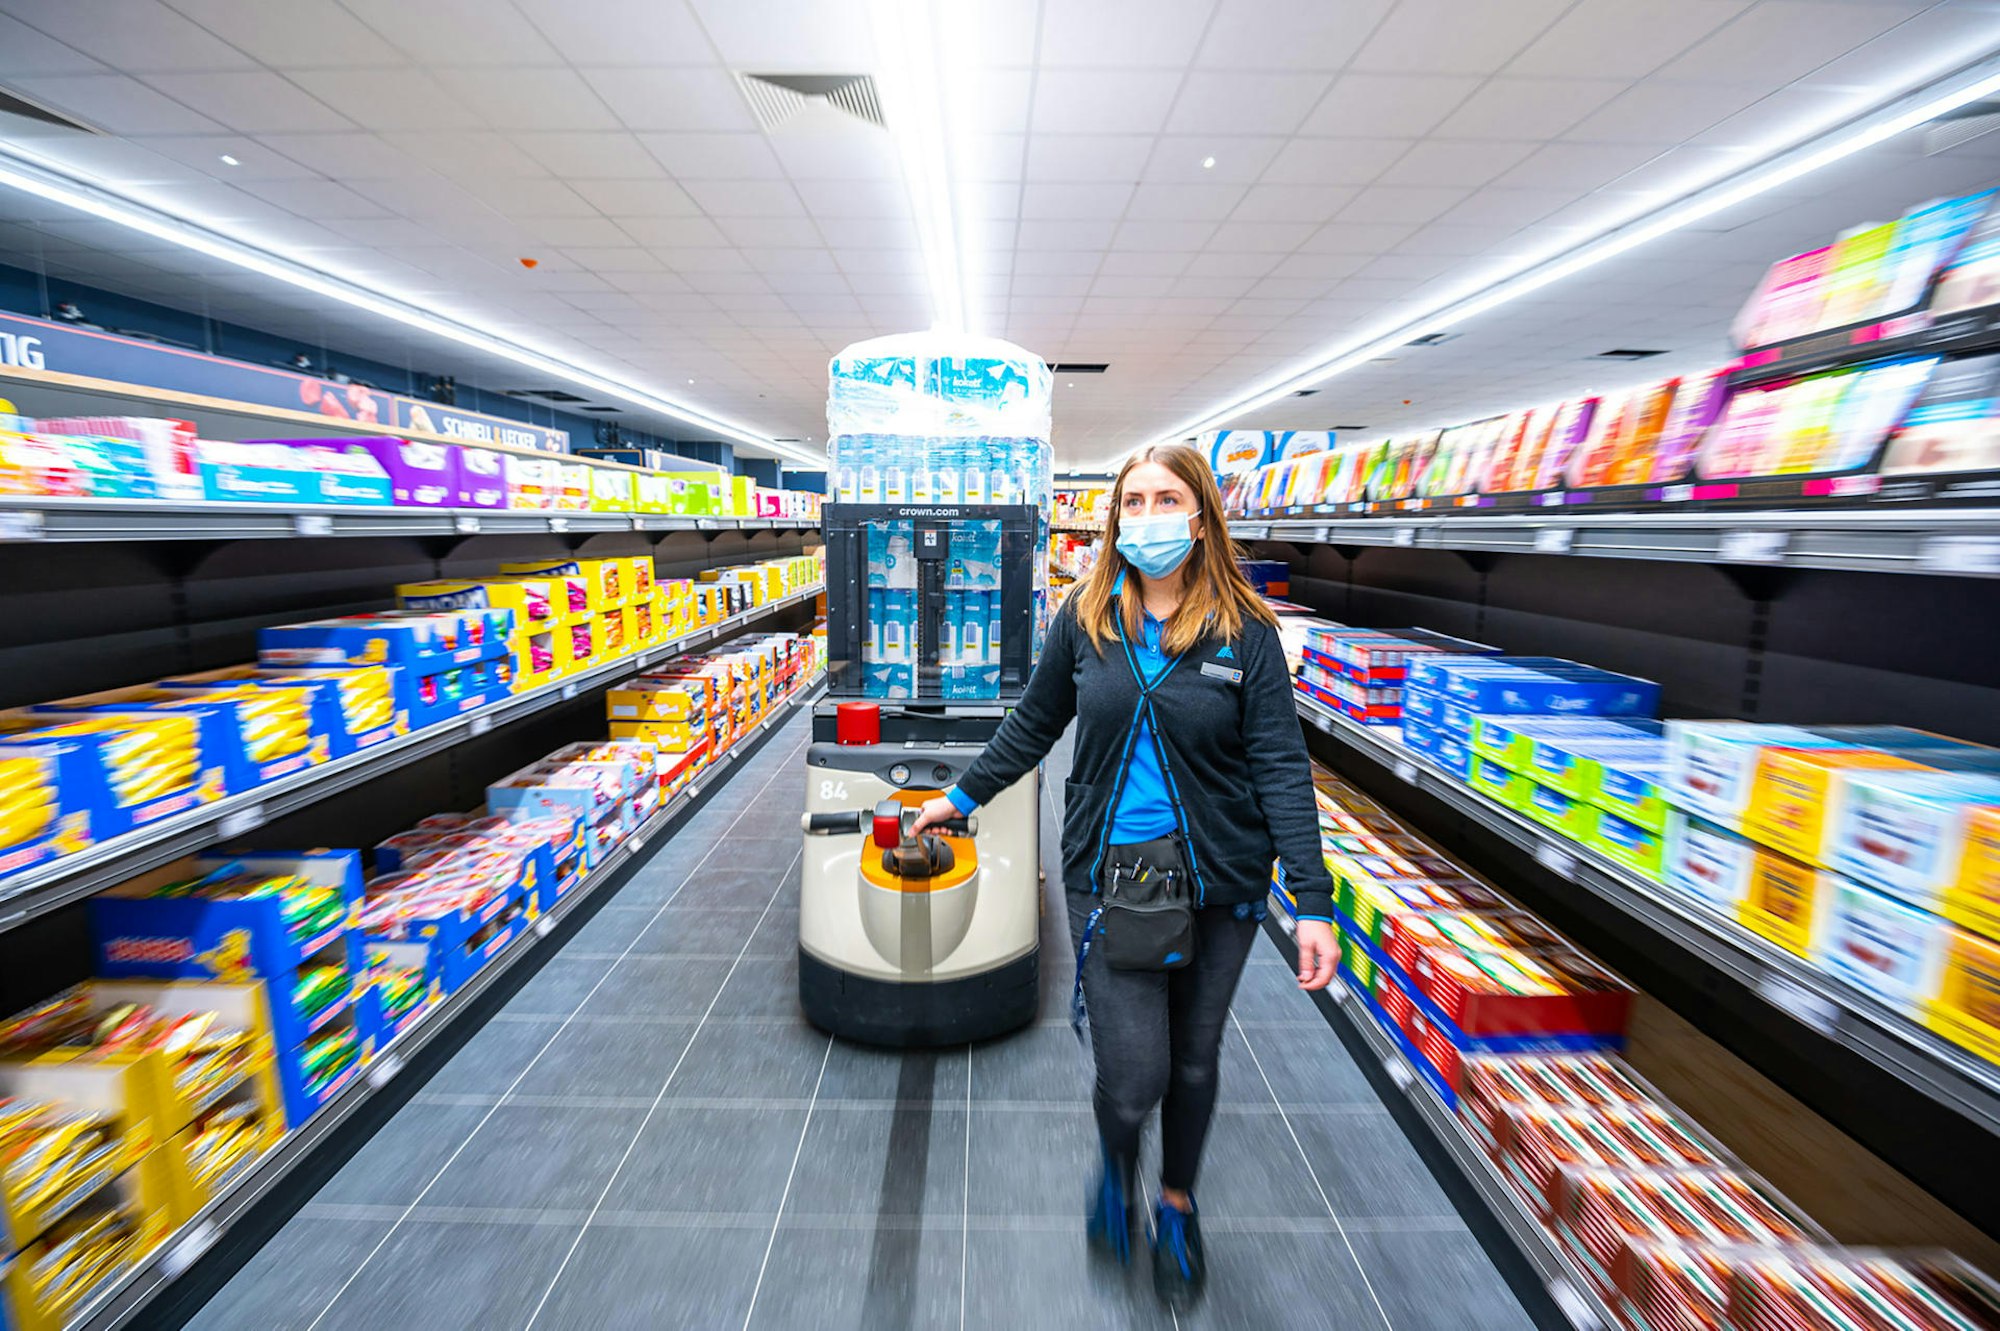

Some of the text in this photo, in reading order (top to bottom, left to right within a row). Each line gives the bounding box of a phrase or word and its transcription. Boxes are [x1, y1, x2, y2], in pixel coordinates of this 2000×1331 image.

[442, 417, 493, 442] SCHNELL
[502, 428, 537, 450] LECKER
[899, 508, 959, 517] crown.com
[821, 780, 849, 800] 84
